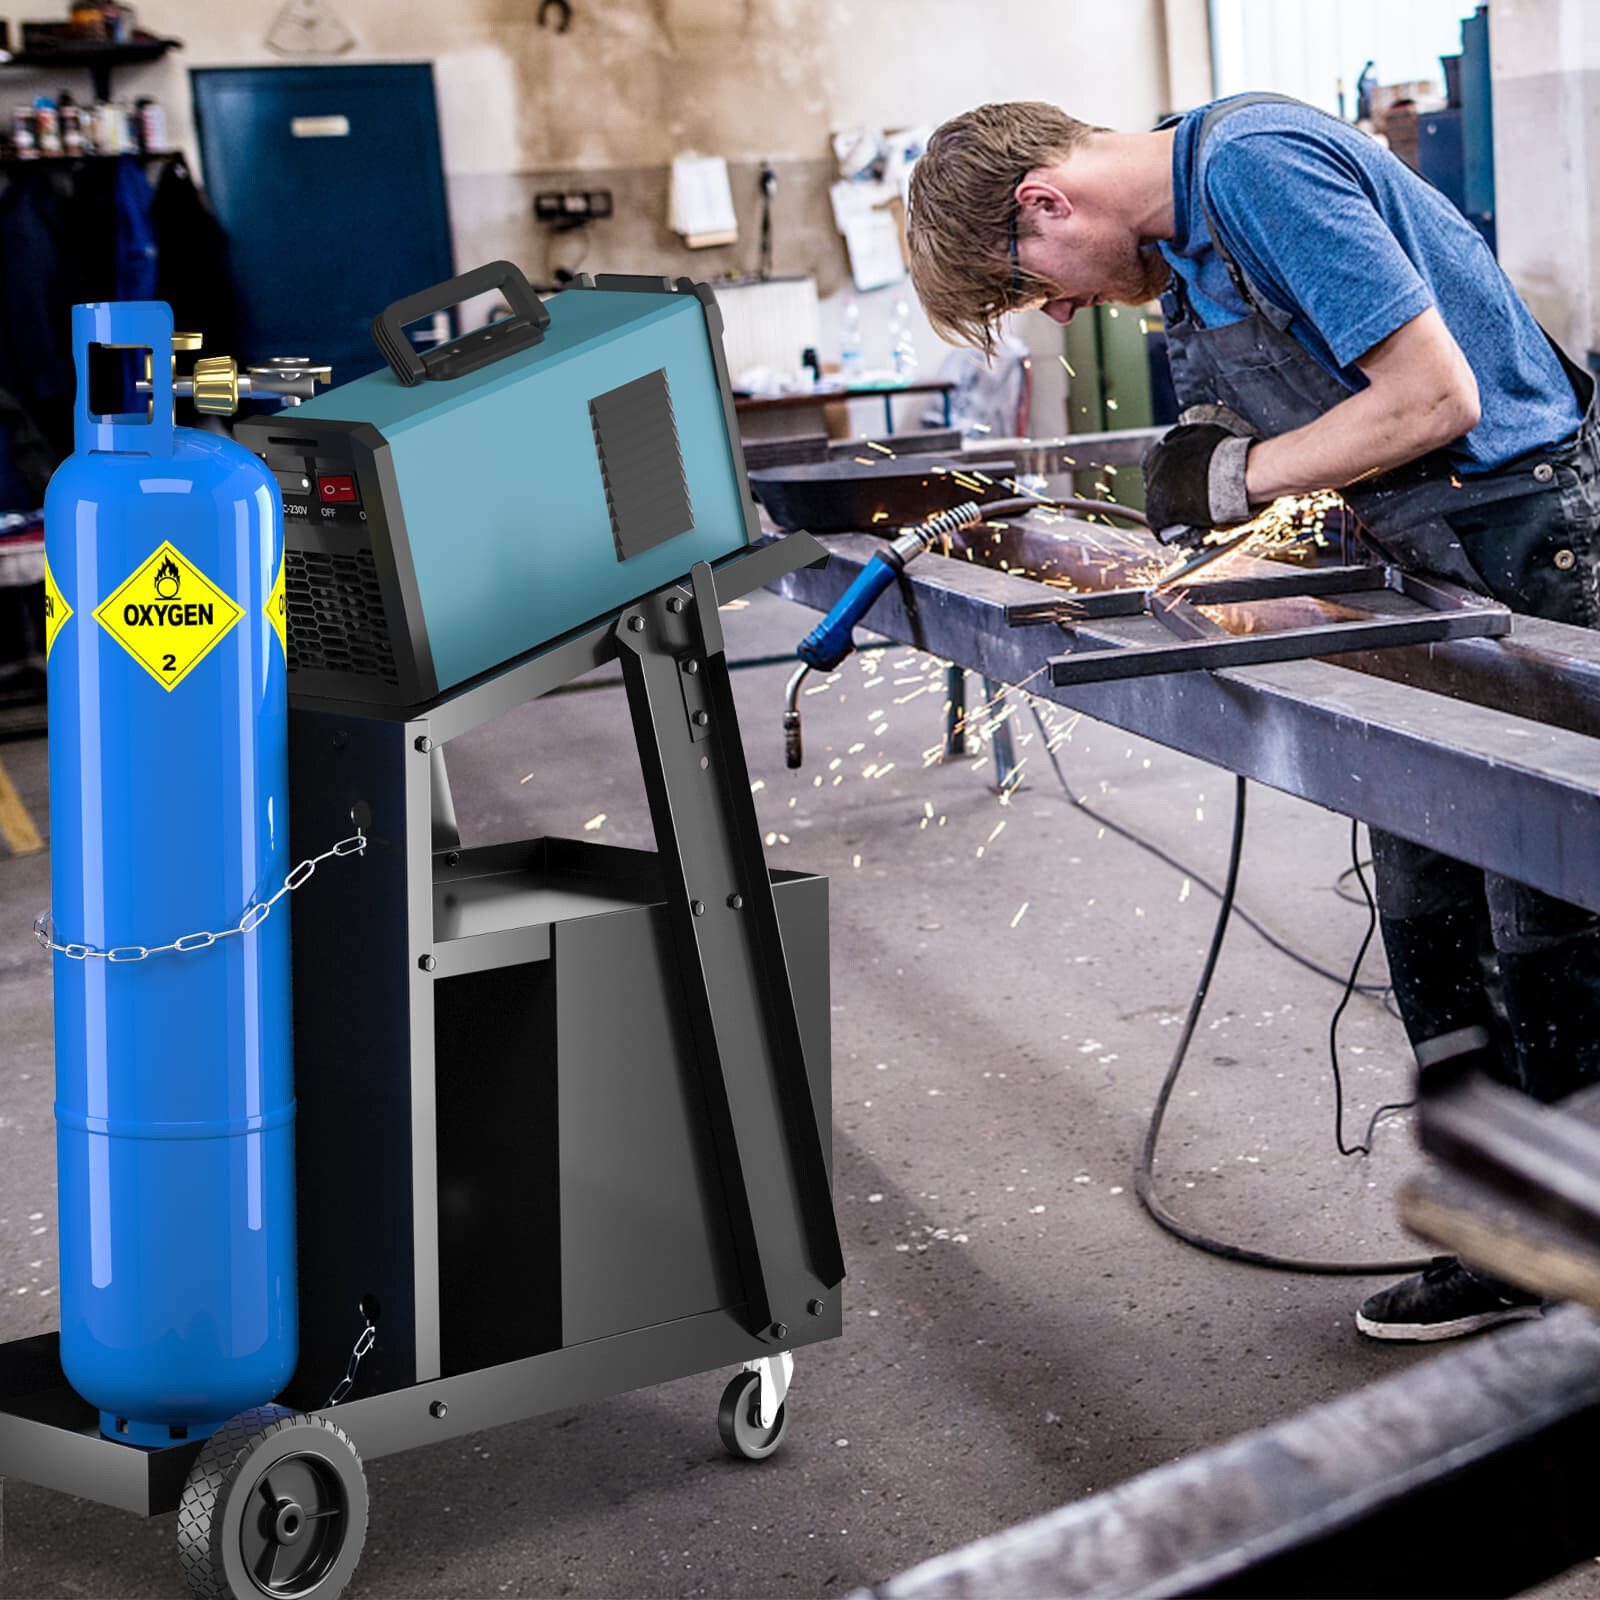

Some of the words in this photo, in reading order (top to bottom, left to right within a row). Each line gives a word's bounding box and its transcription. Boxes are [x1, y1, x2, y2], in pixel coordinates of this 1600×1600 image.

[321, 508, 336, 517] OFF
[123, 603, 214, 627] OXYGEN
[162, 654, 177, 671] 2
